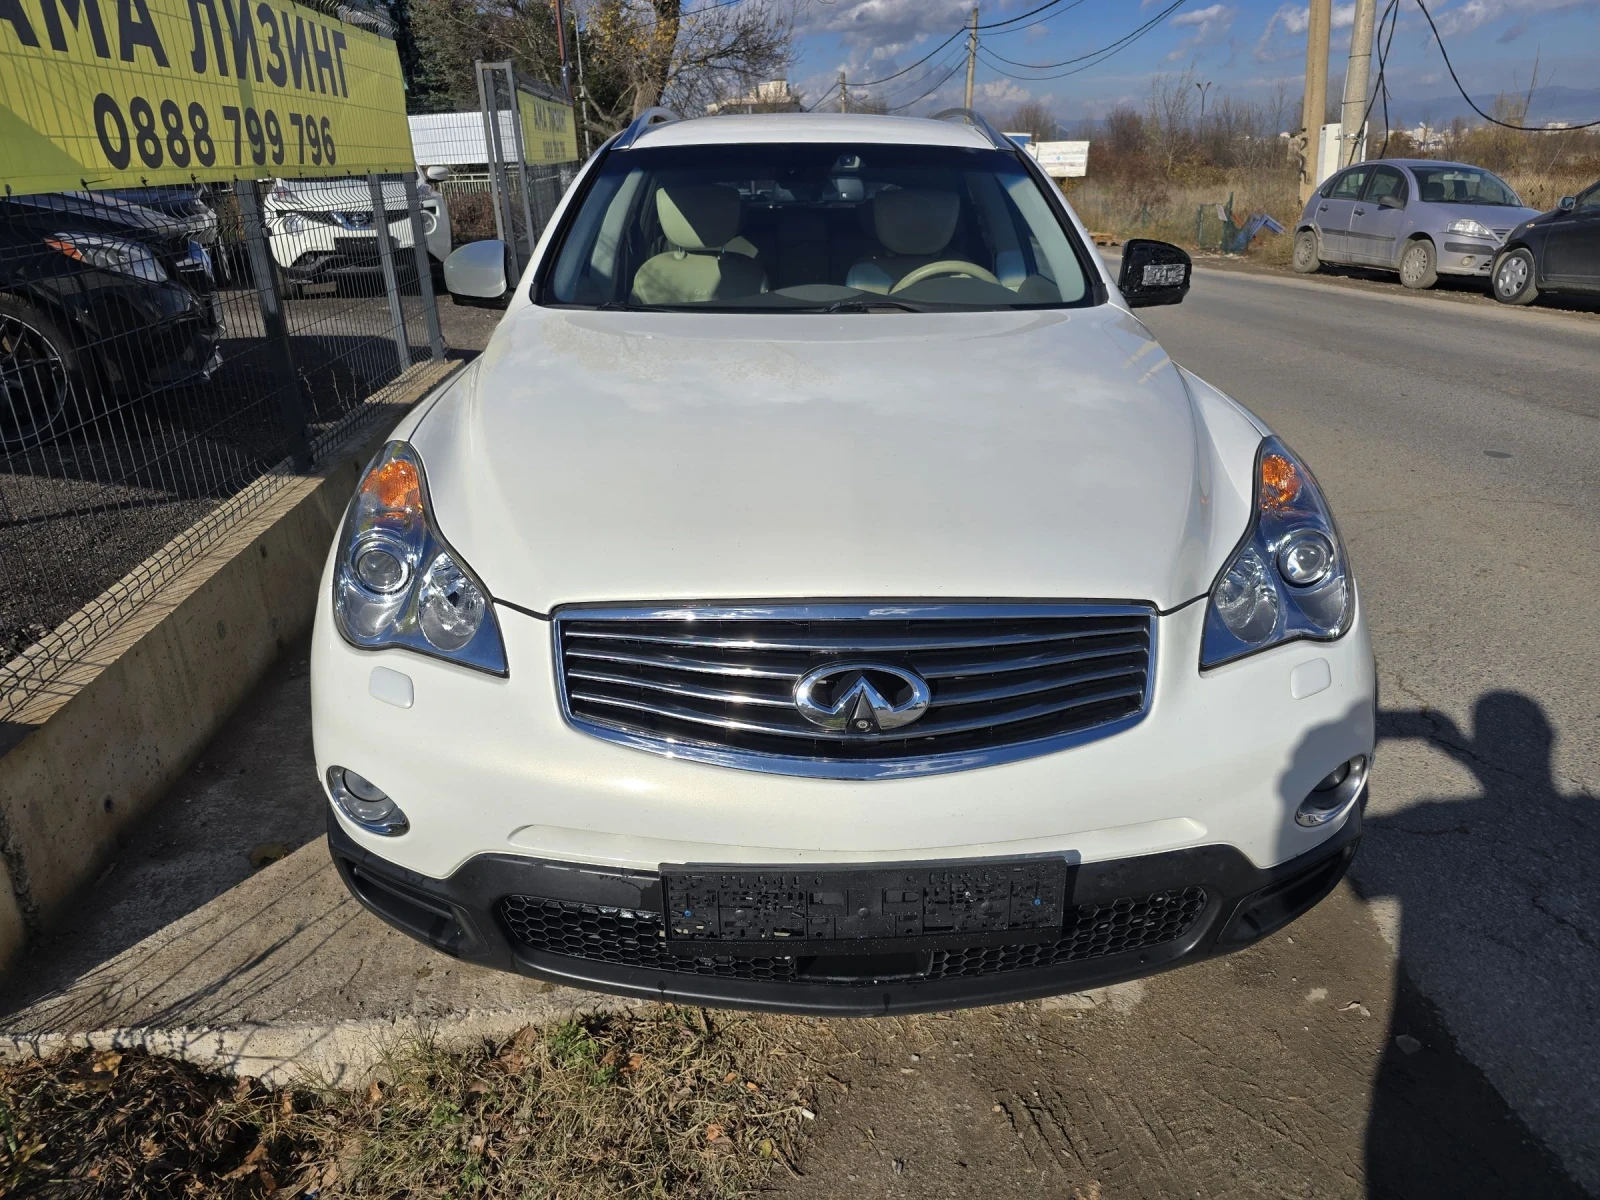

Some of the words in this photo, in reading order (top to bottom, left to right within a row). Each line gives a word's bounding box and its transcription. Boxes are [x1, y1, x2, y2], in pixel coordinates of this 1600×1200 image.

[187, 0, 348, 98] ЛИЗИНГ
[93, 92, 216, 171] 0888
[222, 105, 285, 166] 799
[289, 112, 336, 166] 796
